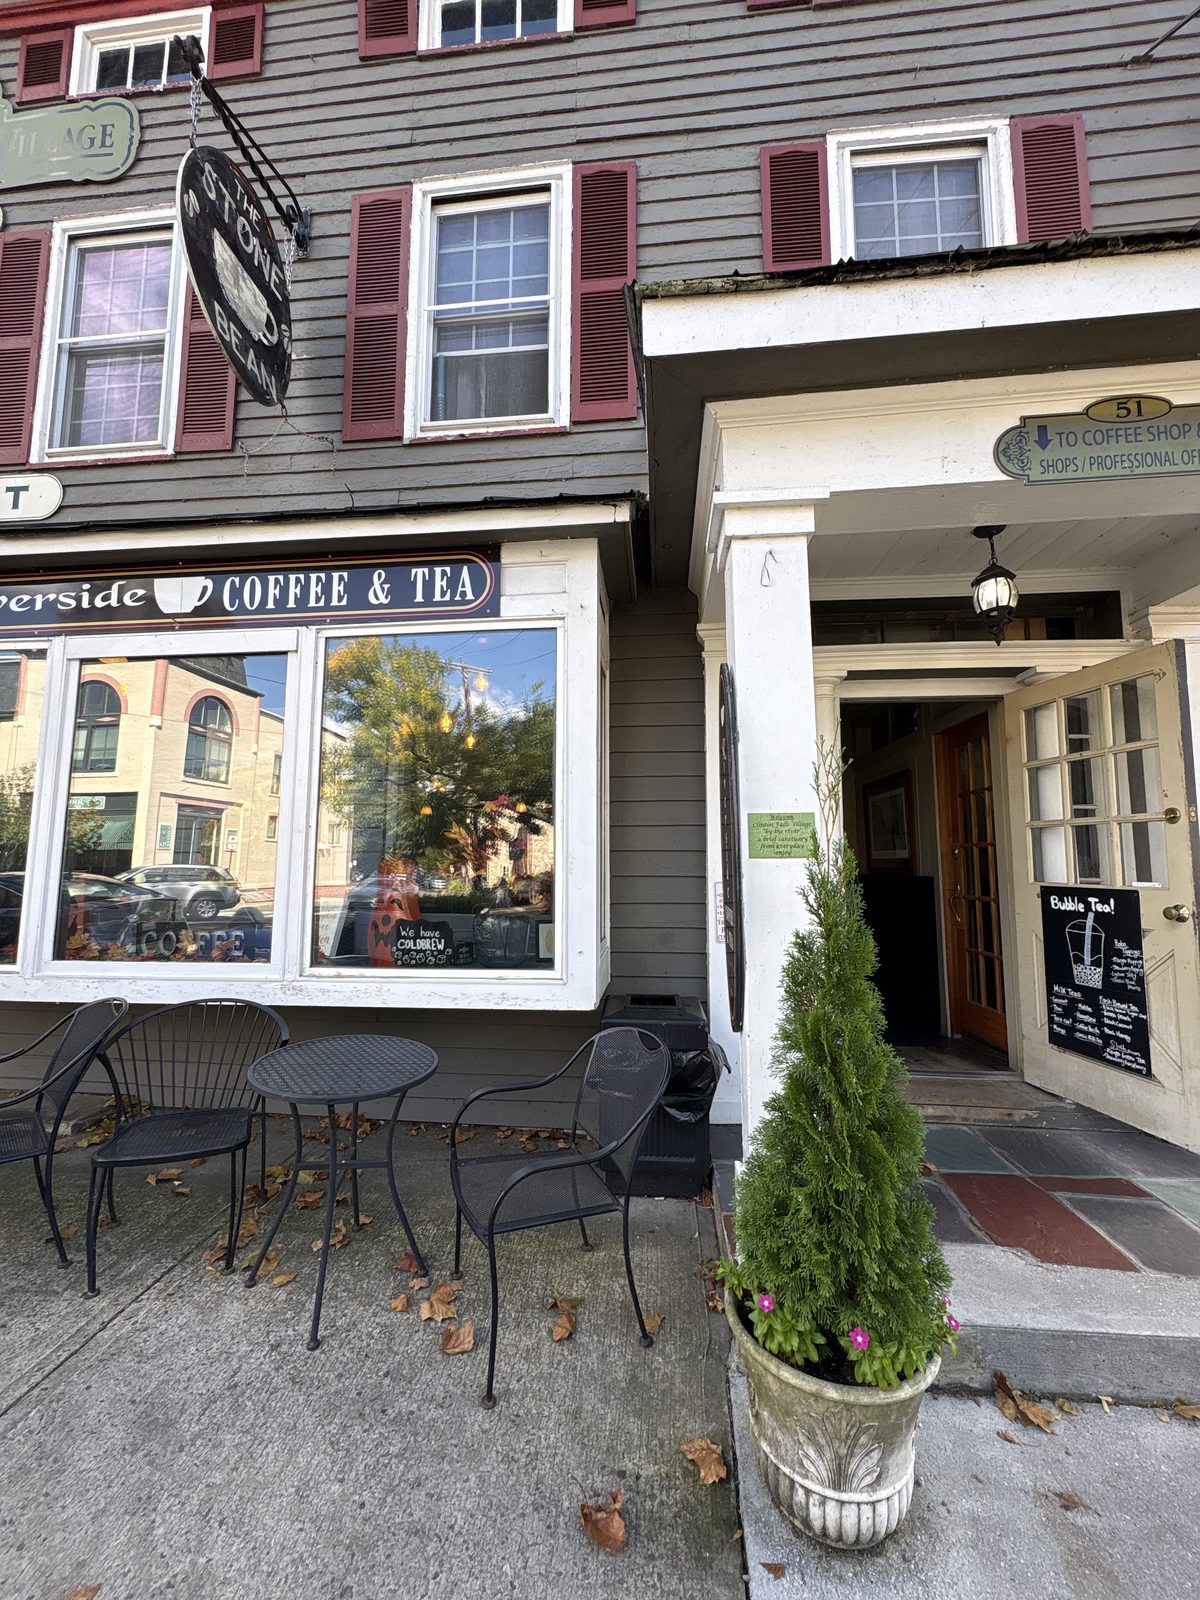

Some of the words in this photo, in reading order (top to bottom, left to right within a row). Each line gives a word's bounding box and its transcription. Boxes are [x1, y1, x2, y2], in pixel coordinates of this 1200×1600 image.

[235, 178, 261, 232] THE
[202, 162, 285, 302] STONE
[213, 300, 278, 404] BEAN
[1116, 400, 1144, 419] 51
[1056, 431, 1078, 448] TO
[1082, 426, 1143, 446] COFFEE
[1147, 423, 1192, 442] SHOP
[1040, 457, 1079, 475] SHOPS
[1081, 457, 1086, 473] /
[1089, 451, 1179, 472] PROFESSIONAL
[1181, 448, 1200, 465] OF
[5, 484, 30, 510] T
[223, 571, 348, 611] COFFEE
[368, 569, 391, 605] &
[411, 565, 475, 603] TEA
[1050, 895, 1085, 913] Bubble
[1087, 897, 1115, 915] Tea!
[140, 930, 245, 957] COFEE
[397, 938, 445, 950] COLDBREW
[400, 925, 415, 937] We
[420, 924, 440, 938] have
[1053, 984, 1066, 994] Milk
